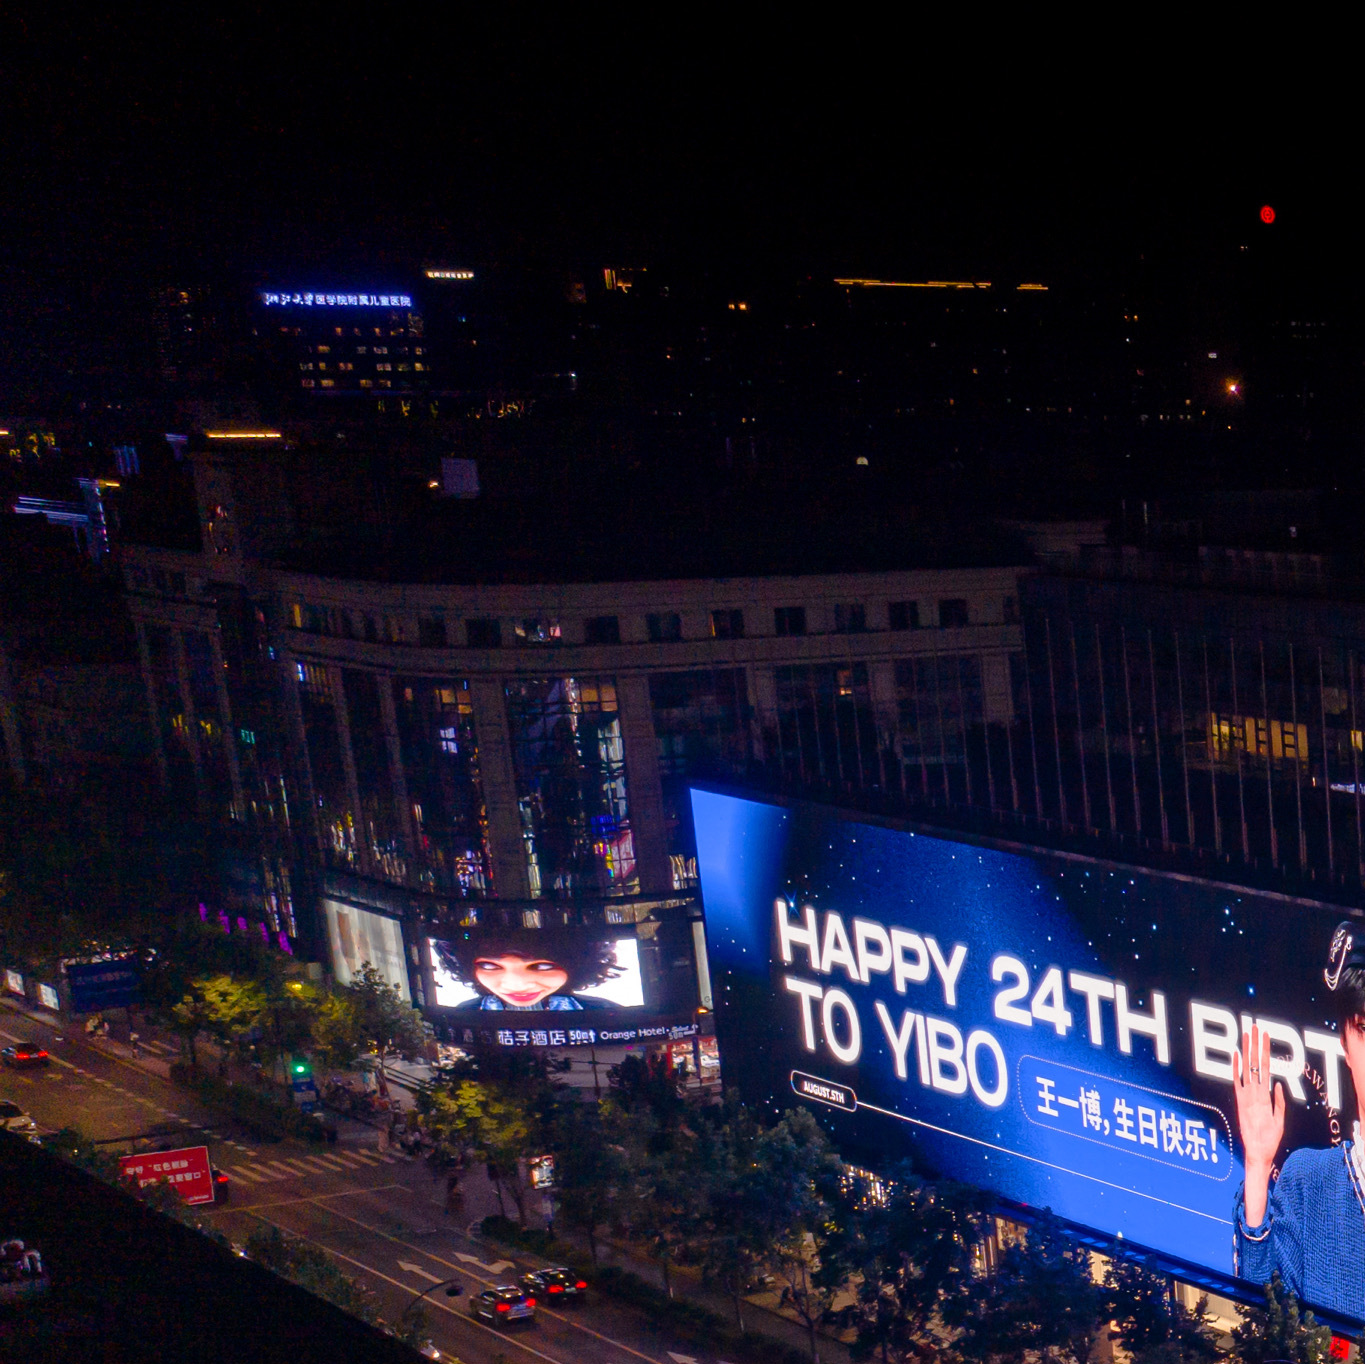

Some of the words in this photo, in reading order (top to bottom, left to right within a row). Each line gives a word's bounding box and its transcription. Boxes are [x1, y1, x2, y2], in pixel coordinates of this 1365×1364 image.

[775, 900, 968, 1006] HAPPY
[991, 955, 1171, 1066] 24TH
[498, 1029, 565, 1047] 桔子酒店
[600, 1029, 637, 1041] Orange
[638, 1027, 666, 1038] Hotel
[785, 976, 862, 1064] TO
[875, 1002, 1008, 1108] YIBO
